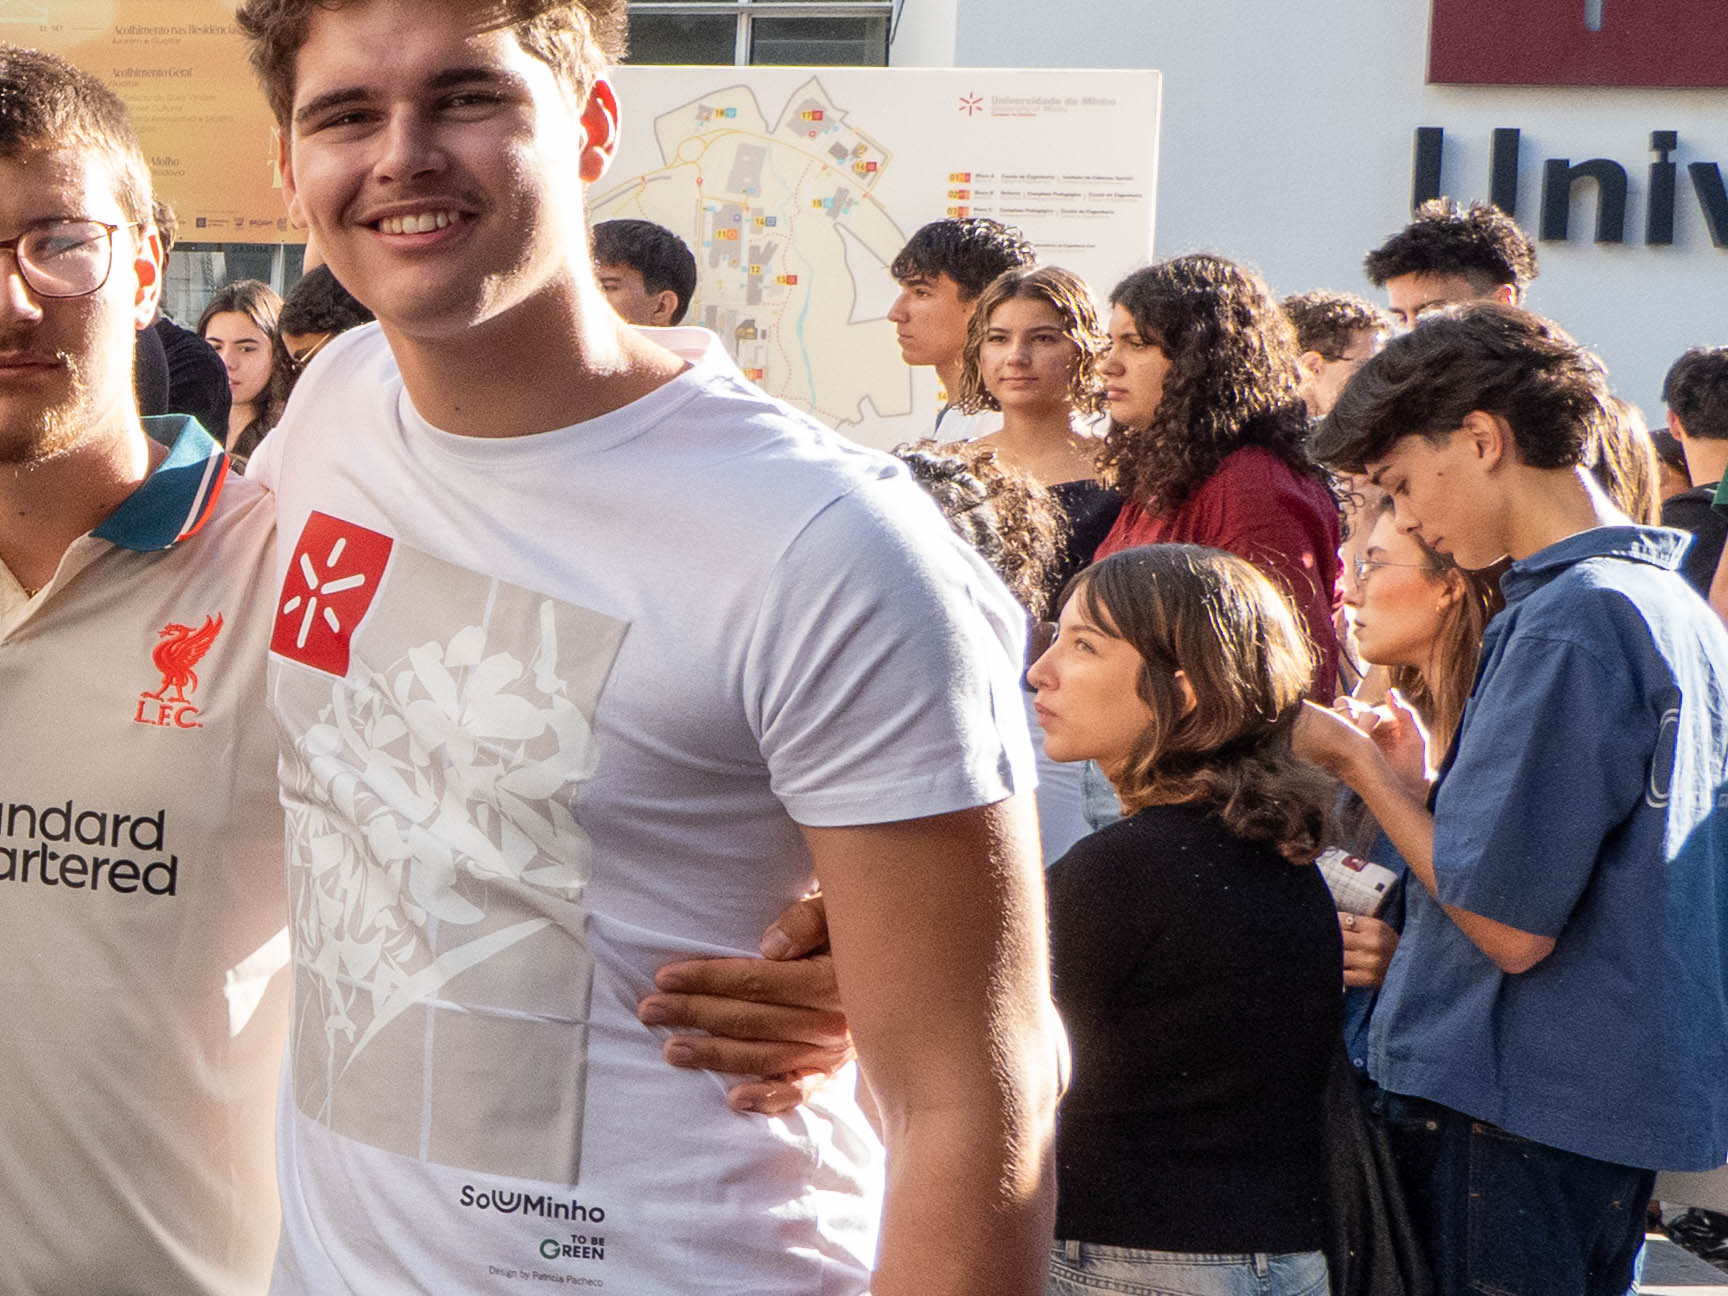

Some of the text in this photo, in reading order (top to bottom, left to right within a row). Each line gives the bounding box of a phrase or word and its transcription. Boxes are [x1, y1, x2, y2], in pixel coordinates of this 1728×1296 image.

[539, 1238, 606, 1261] GREEN
[571, 1234, 606, 1247] TO BE
